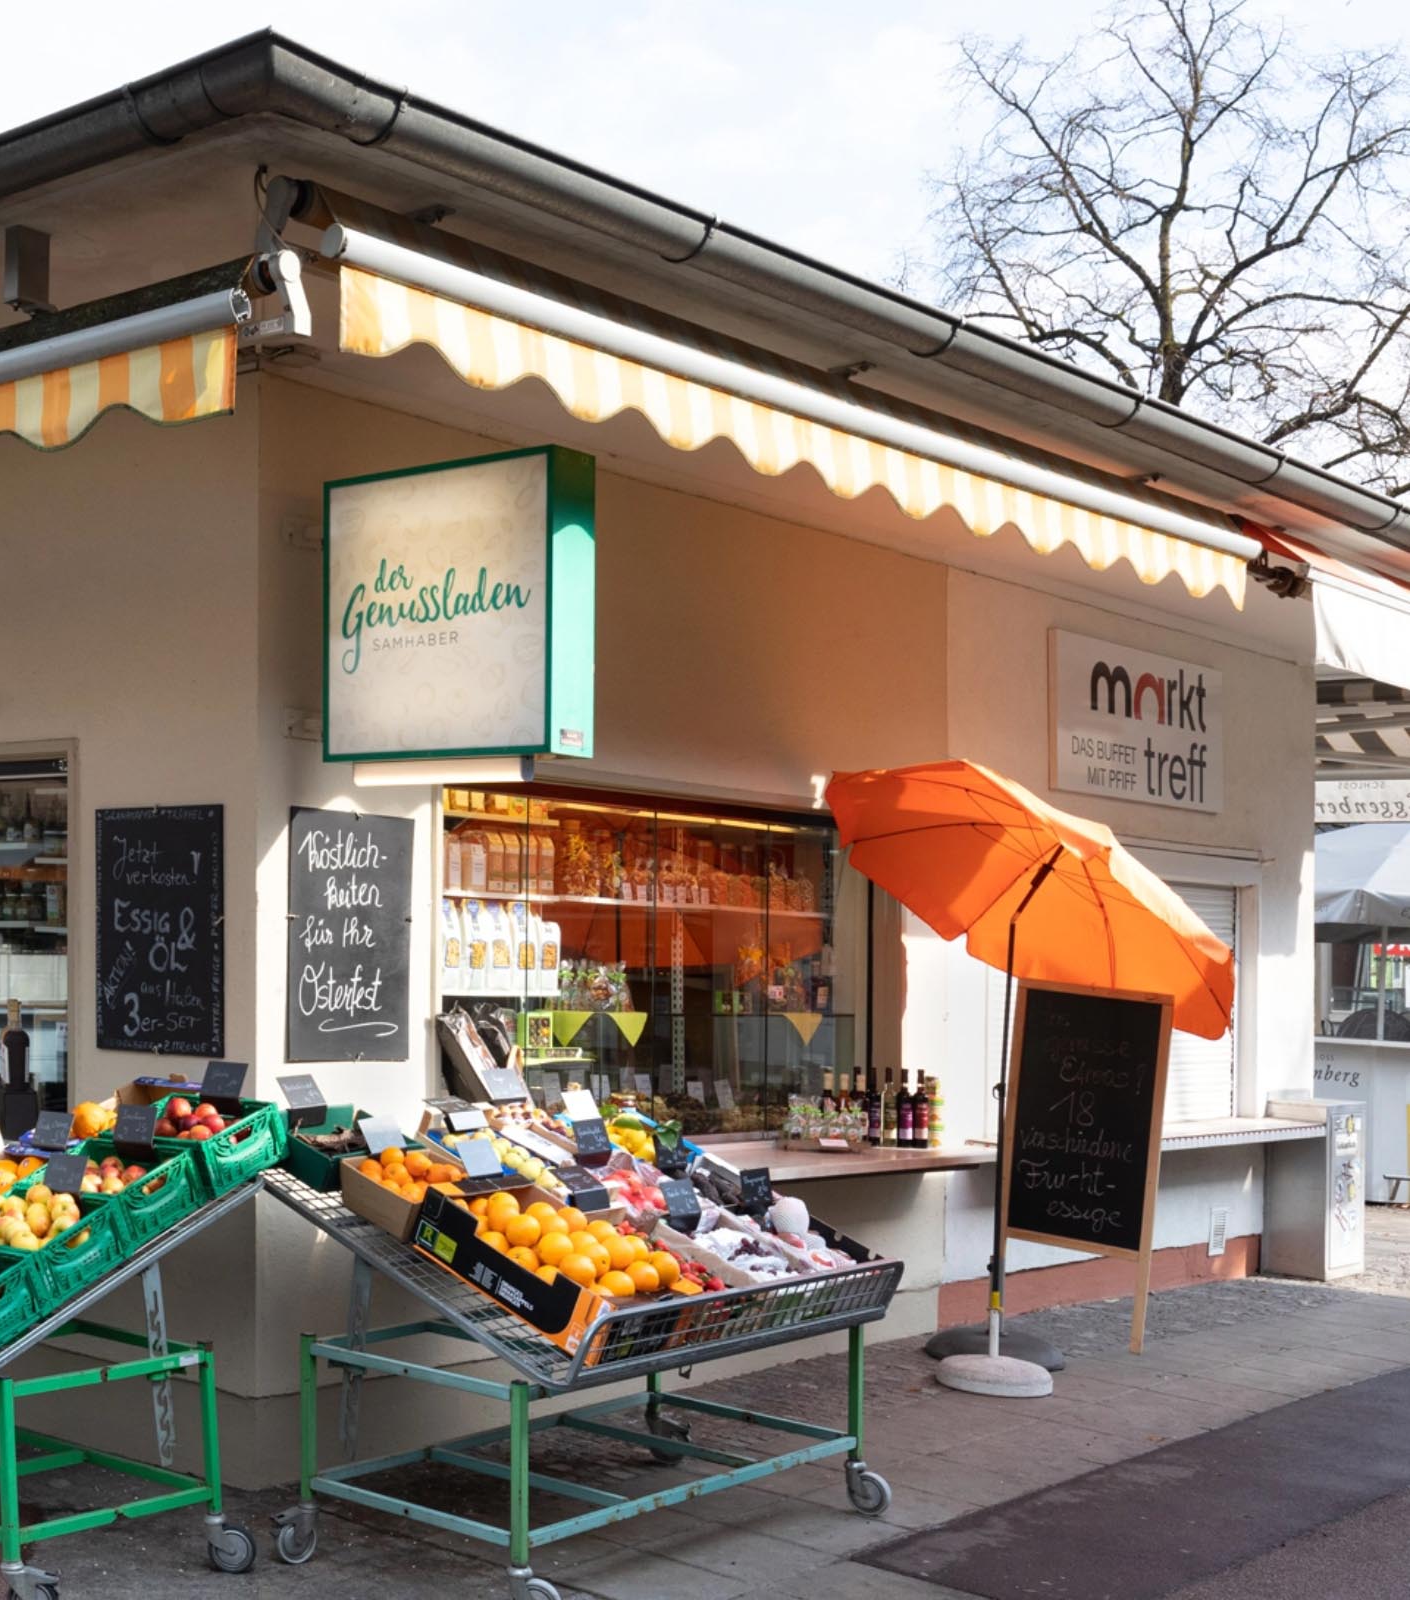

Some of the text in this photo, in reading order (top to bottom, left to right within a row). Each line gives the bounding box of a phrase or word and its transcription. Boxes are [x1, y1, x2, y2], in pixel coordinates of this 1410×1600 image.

[374, 558, 414, 593] der
[342, 566, 531, 675] Genussladen
[372, 631, 459, 651] SAMHABER
[1091, 661, 1207, 733] markt
[1071, 735, 1137, 765] DAS BUFFET
[1088, 766, 1137, 792] MIT PFIFF
[1144, 737, 1207, 803] treff
[112, 835, 167, 880] Jetzt
[298, 828, 388, 873] Köstlich-
[323, 873, 383, 910] keiten
[177, 906, 197, 950] &
[299, 915, 376, 952] für Ihr
[299, 961, 383, 1017] Osterfest
[1314, 1064, 1360, 1088] nberg
[1049, 1090, 1095, 1127] 18
